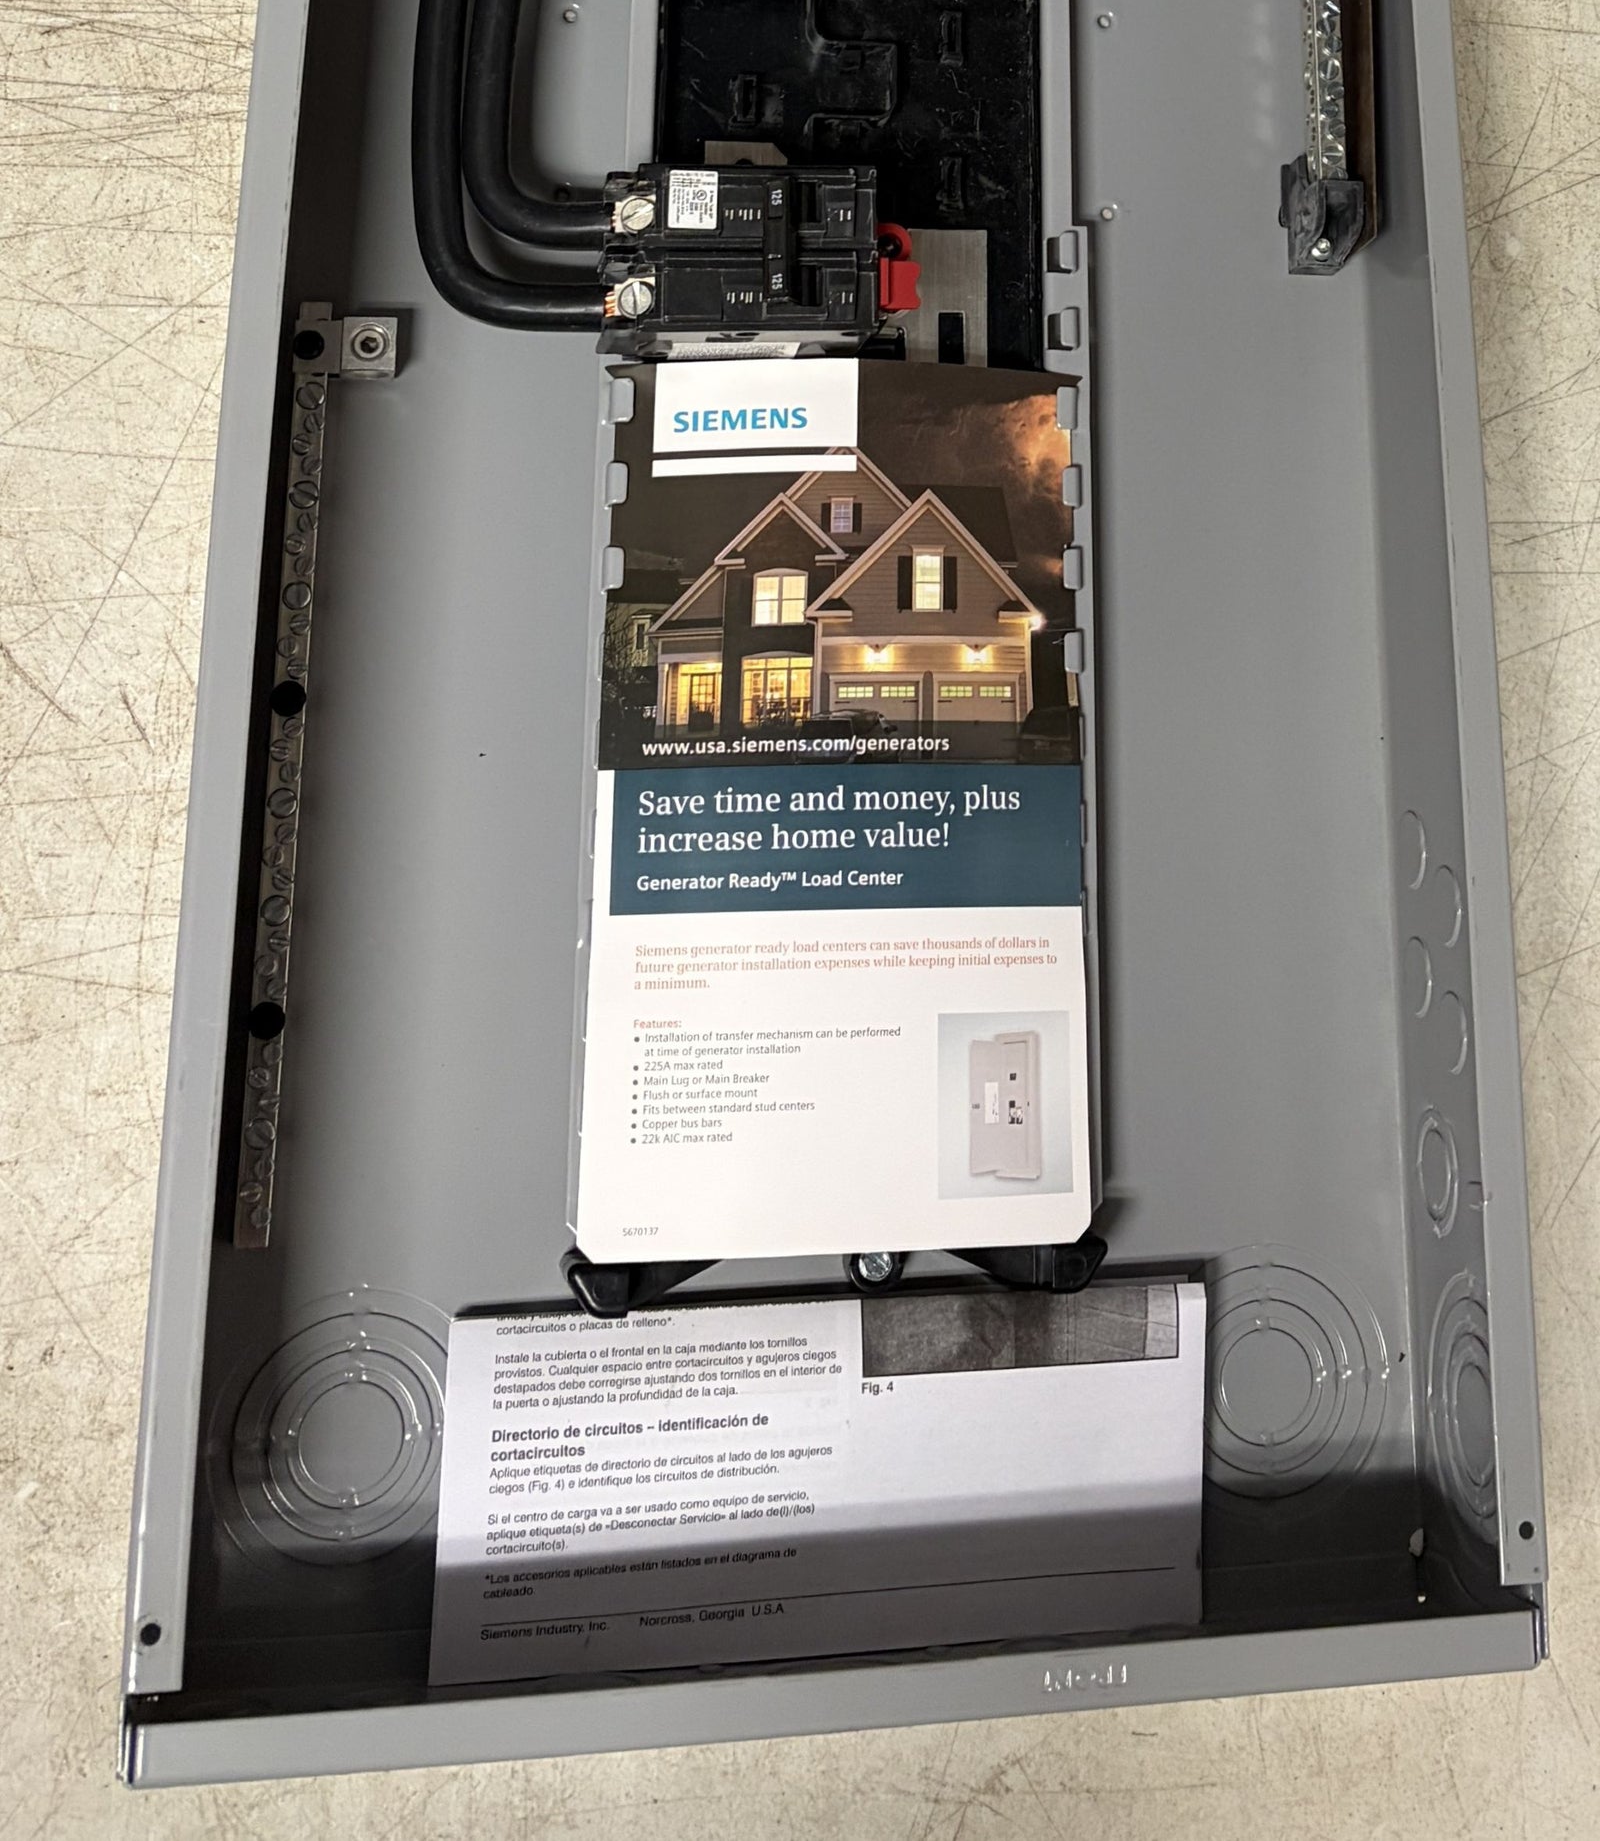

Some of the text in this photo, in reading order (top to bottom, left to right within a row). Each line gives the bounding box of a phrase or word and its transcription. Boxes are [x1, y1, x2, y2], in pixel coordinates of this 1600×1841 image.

[770, 189, 783, 206] 125
[771, 273, 783, 290] 125
[673, 407, 807, 432] SIEMENS
[641, 734, 949, 755] www.usa.siemens.com/generators
[638, 784, 1020, 816] Save time and money, plus
[637, 821, 948, 853] increase home value!
[636, 874, 724, 890] Generator
[801, 869, 842, 886] Load
[847, 870, 903, 885] Center
[635, 936, 1049, 958] Siemens generator ready load centers can save thousands of dollars in
[634, 953, 1057, 975] future generator installation expenses while keeping initial expenses to
[633, 977, 710, 990] a minimum.
[633, 1018, 681, 1028] Features:
[644, 1025, 900, 1042] Installation of transfer mechanism can be performed
[643, 1042, 801, 1058] at time of generator installation
[643, 1059, 723, 1071] 225A max rated
[643, 1072, 770, 1087] Main Lug or Main Breaker
[642, 1088, 757, 1100] Flush or surface mount
[642, 1101, 815, 1114] Fits between standard stud centers
[641, 1117, 722, 1131] Copper bus bars
[641, 1131, 732, 1144] 22k AIC max rated
[622, 1226, 658, 1236] 5670137
[494, 1337, 807, 1364] Instale la cubierta o el frontal en la caja mediante los tornillos
[494, 1350, 836, 1381] provistos. Cualquier espacio entre cortacircuitos y agujeros ciegos
[861, 1380, 893, 1395] Fig. 4
[492, 1385, 738, 1411] la puerta o ajustando la profundidad de la caja.
[491, 1413, 768, 1442] Directorio de circuitos identificación de
[490, 1444, 585, 1461] cortacircuitos
[480, 1627, 532, 1640] Siemens
